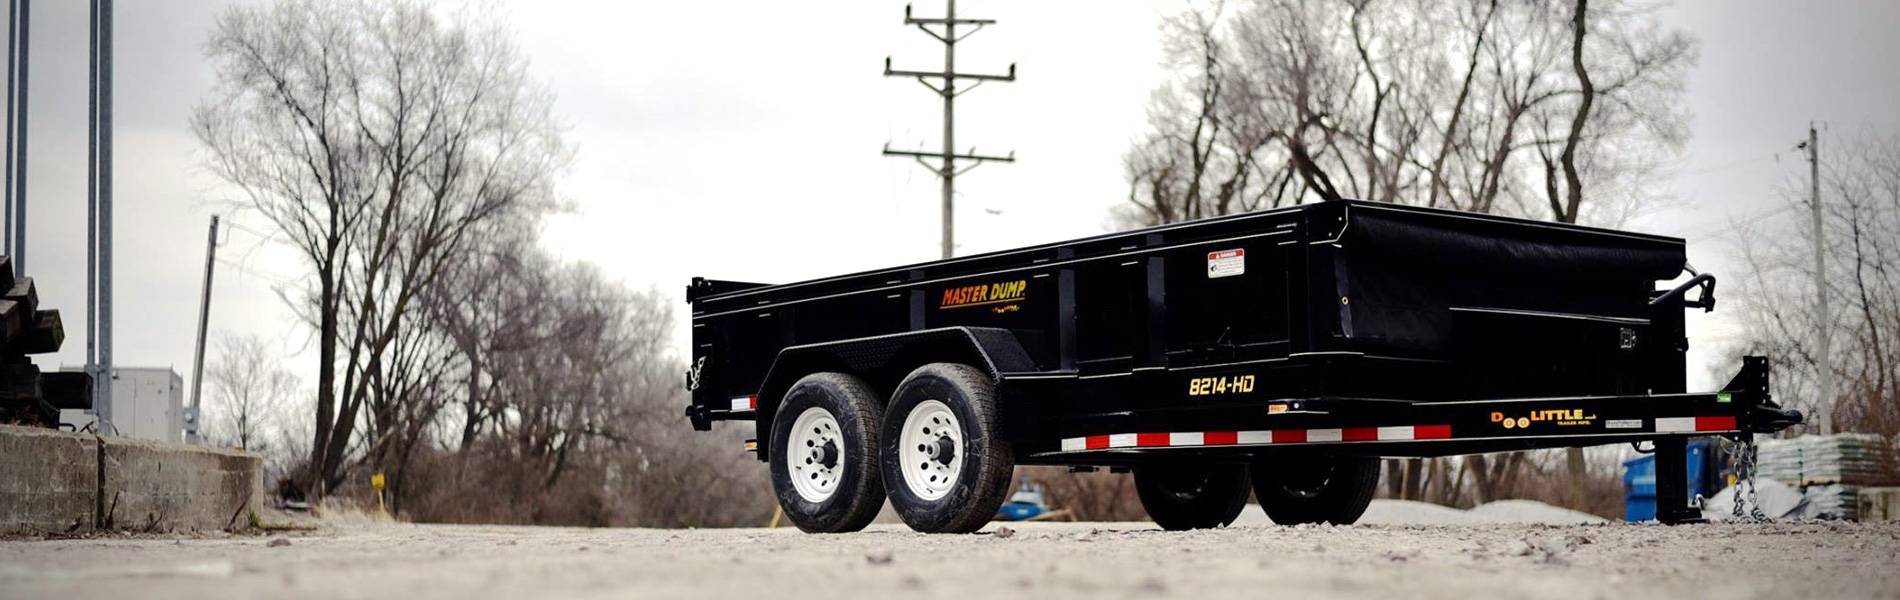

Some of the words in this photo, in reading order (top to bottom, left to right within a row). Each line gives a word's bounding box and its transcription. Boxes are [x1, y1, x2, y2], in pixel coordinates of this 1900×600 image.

[942, 285, 988, 305] MASTER
[990, 280, 1026, 300] DUMP
[1189, 375, 1255, 396] 8214-HD
